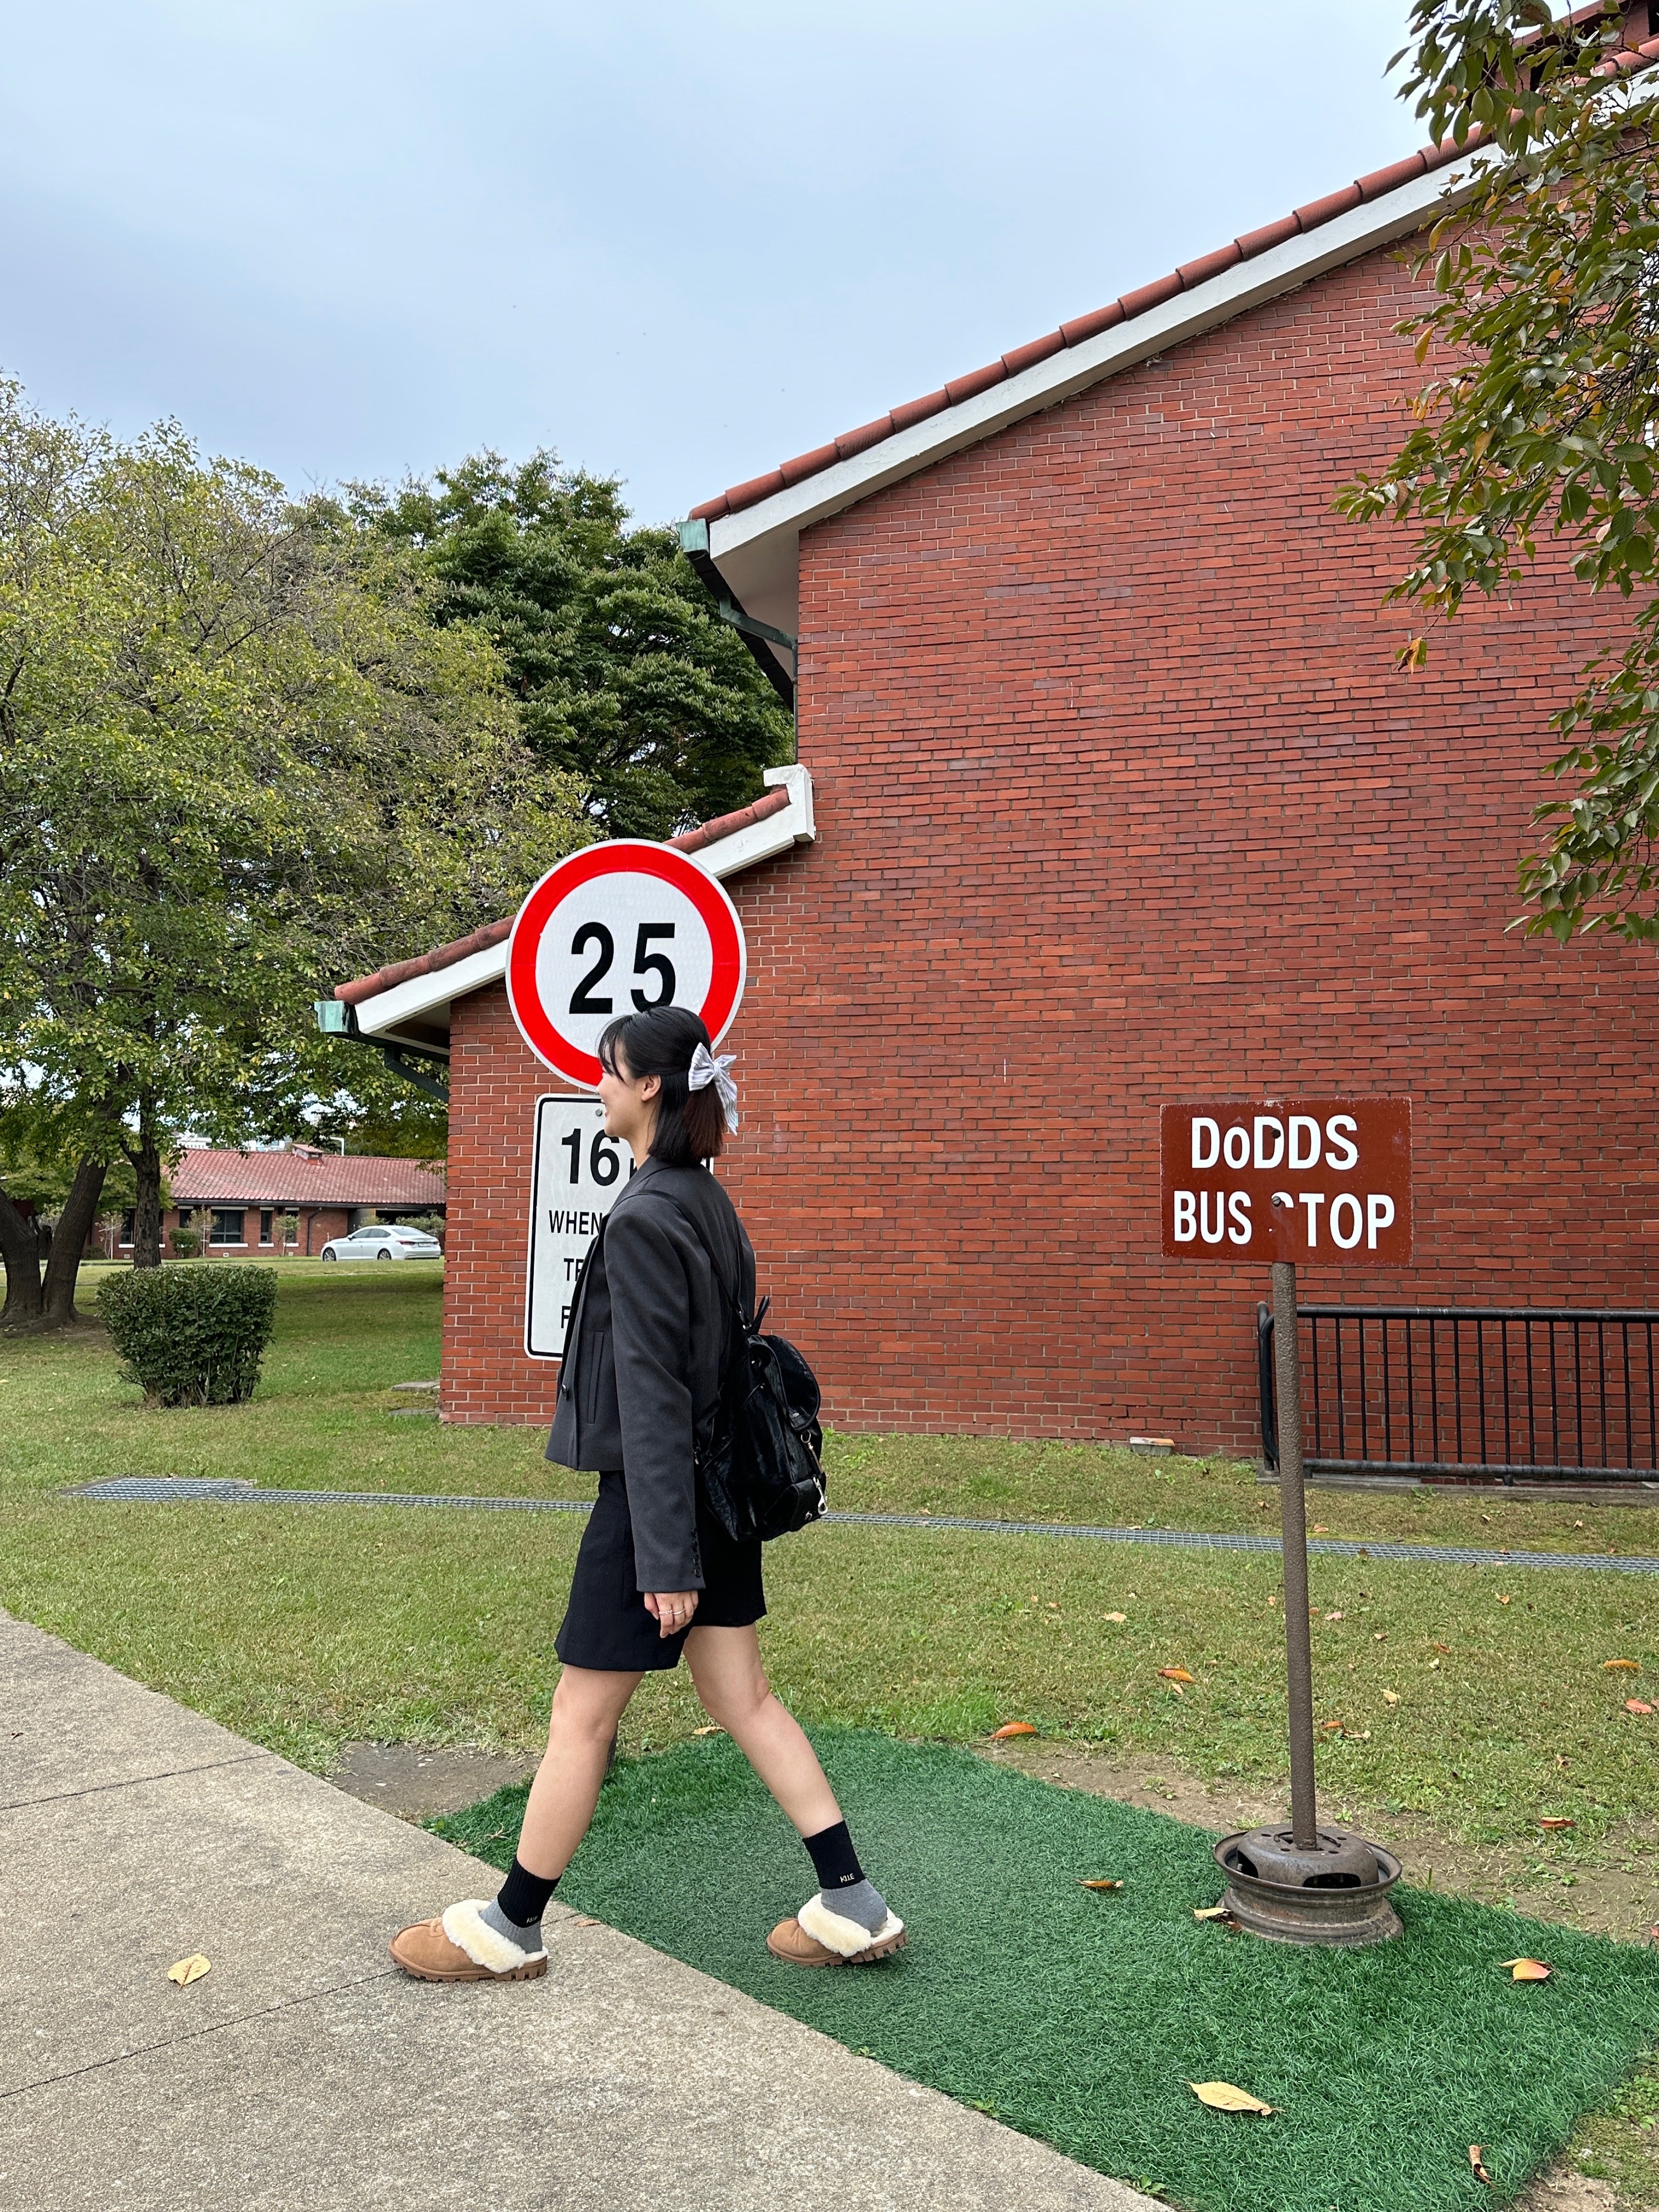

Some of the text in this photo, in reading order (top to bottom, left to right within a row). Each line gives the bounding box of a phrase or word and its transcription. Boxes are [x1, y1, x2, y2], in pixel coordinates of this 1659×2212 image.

[569, 921, 675, 1014] 25
[549, 1210, 603, 1235] WHEN
[1174, 1190, 1252, 1245] BUS
